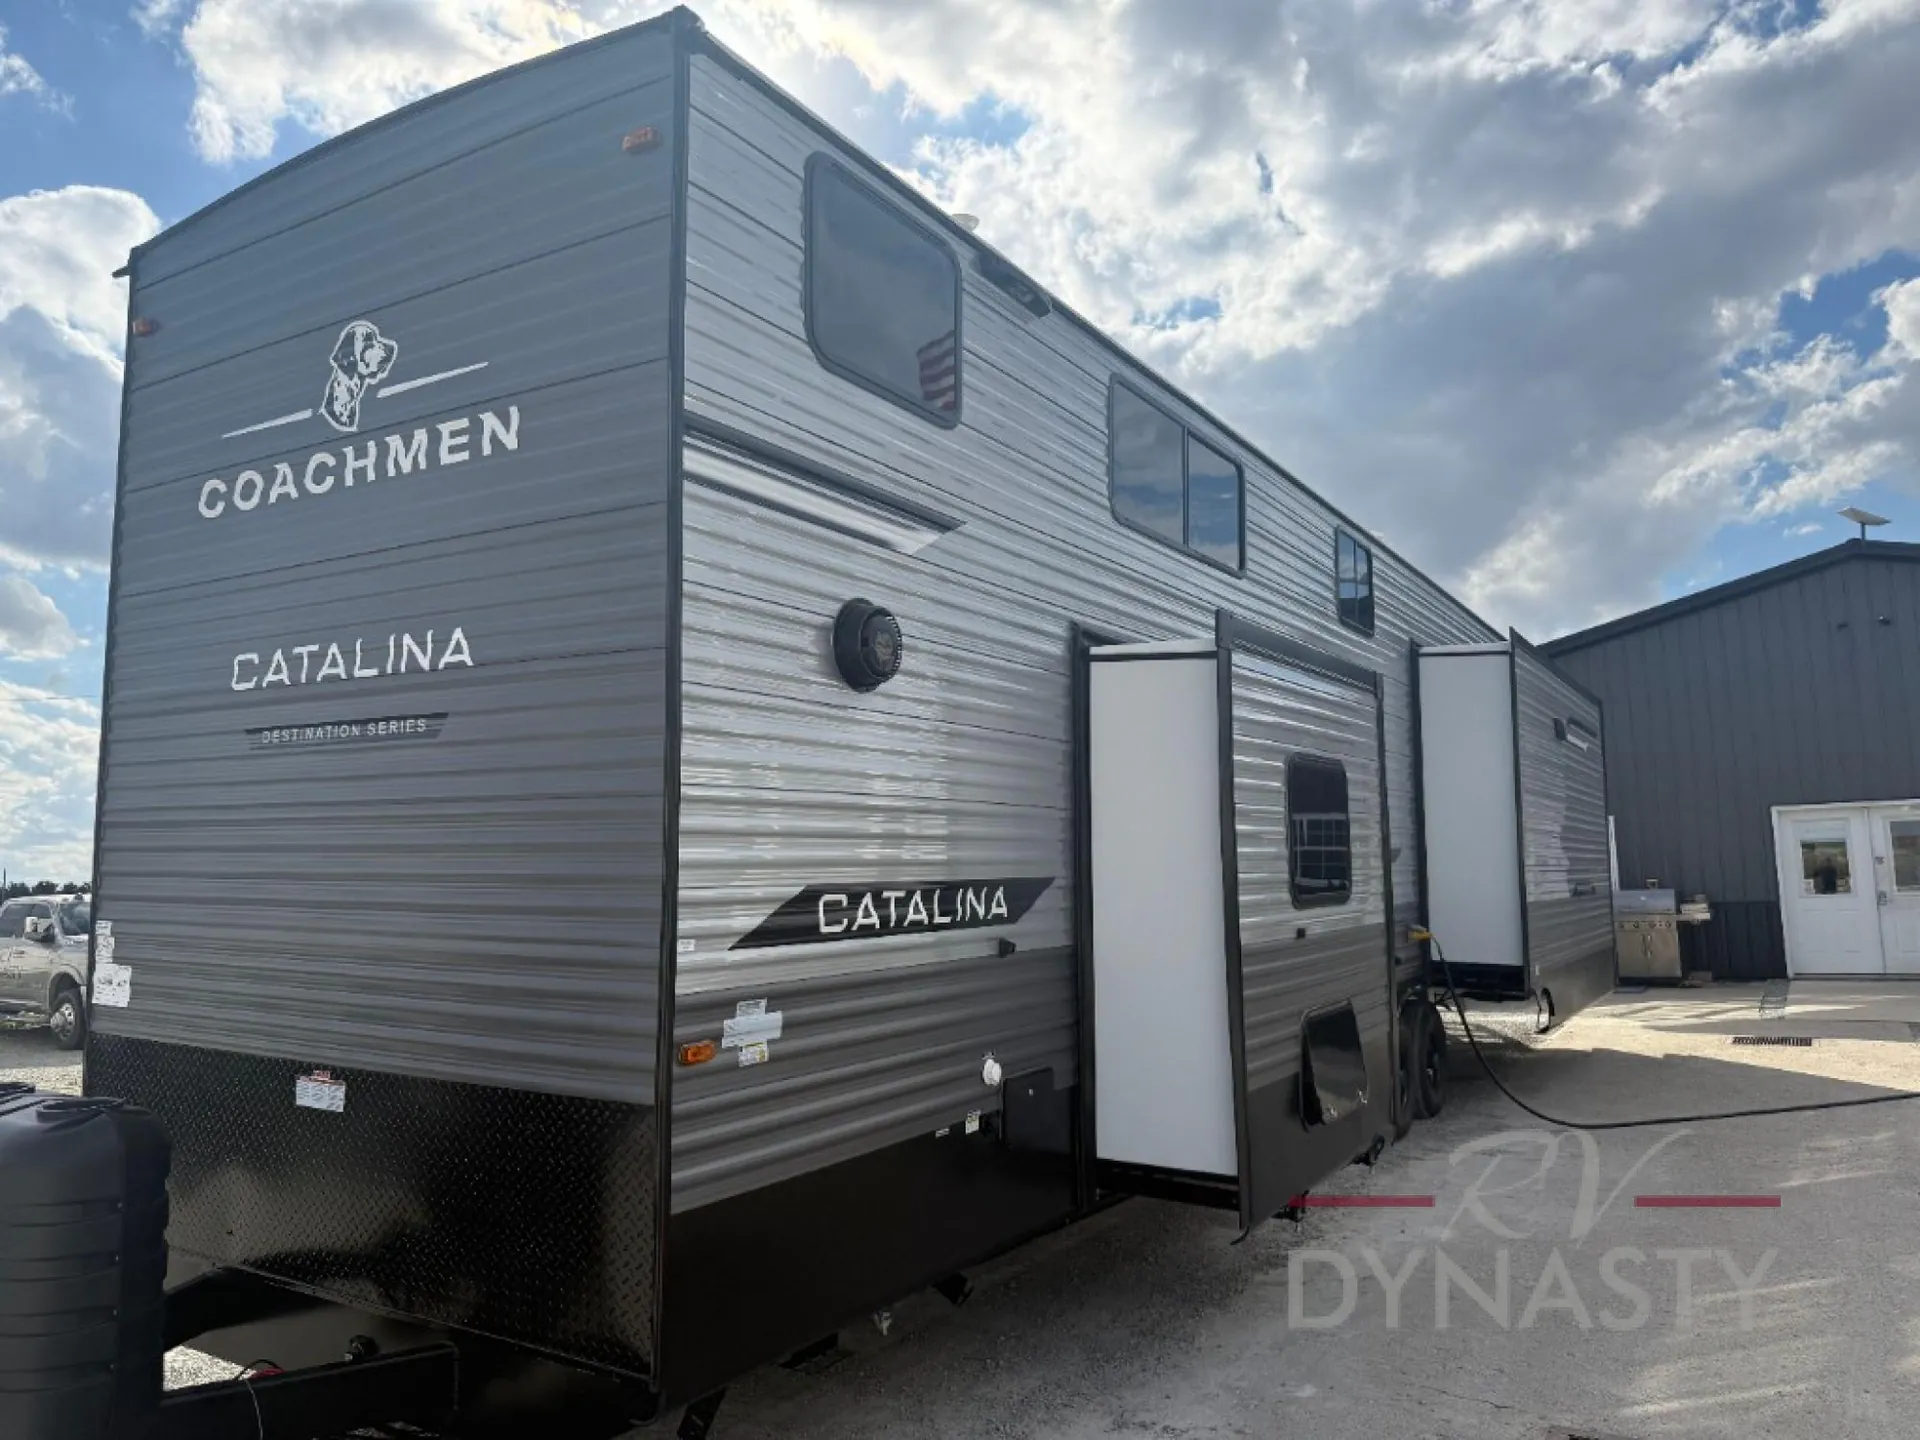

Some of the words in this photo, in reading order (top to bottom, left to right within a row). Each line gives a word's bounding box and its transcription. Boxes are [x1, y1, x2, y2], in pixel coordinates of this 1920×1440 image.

[198, 405, 520, 518] COACHMEN
[231, 627, 474, 691] CATALINA
[262, 723, 361, 744] DESTINATION
[366, 719, 428, 736] SERIES
[818, 885, 1009, 933] CATALINA
